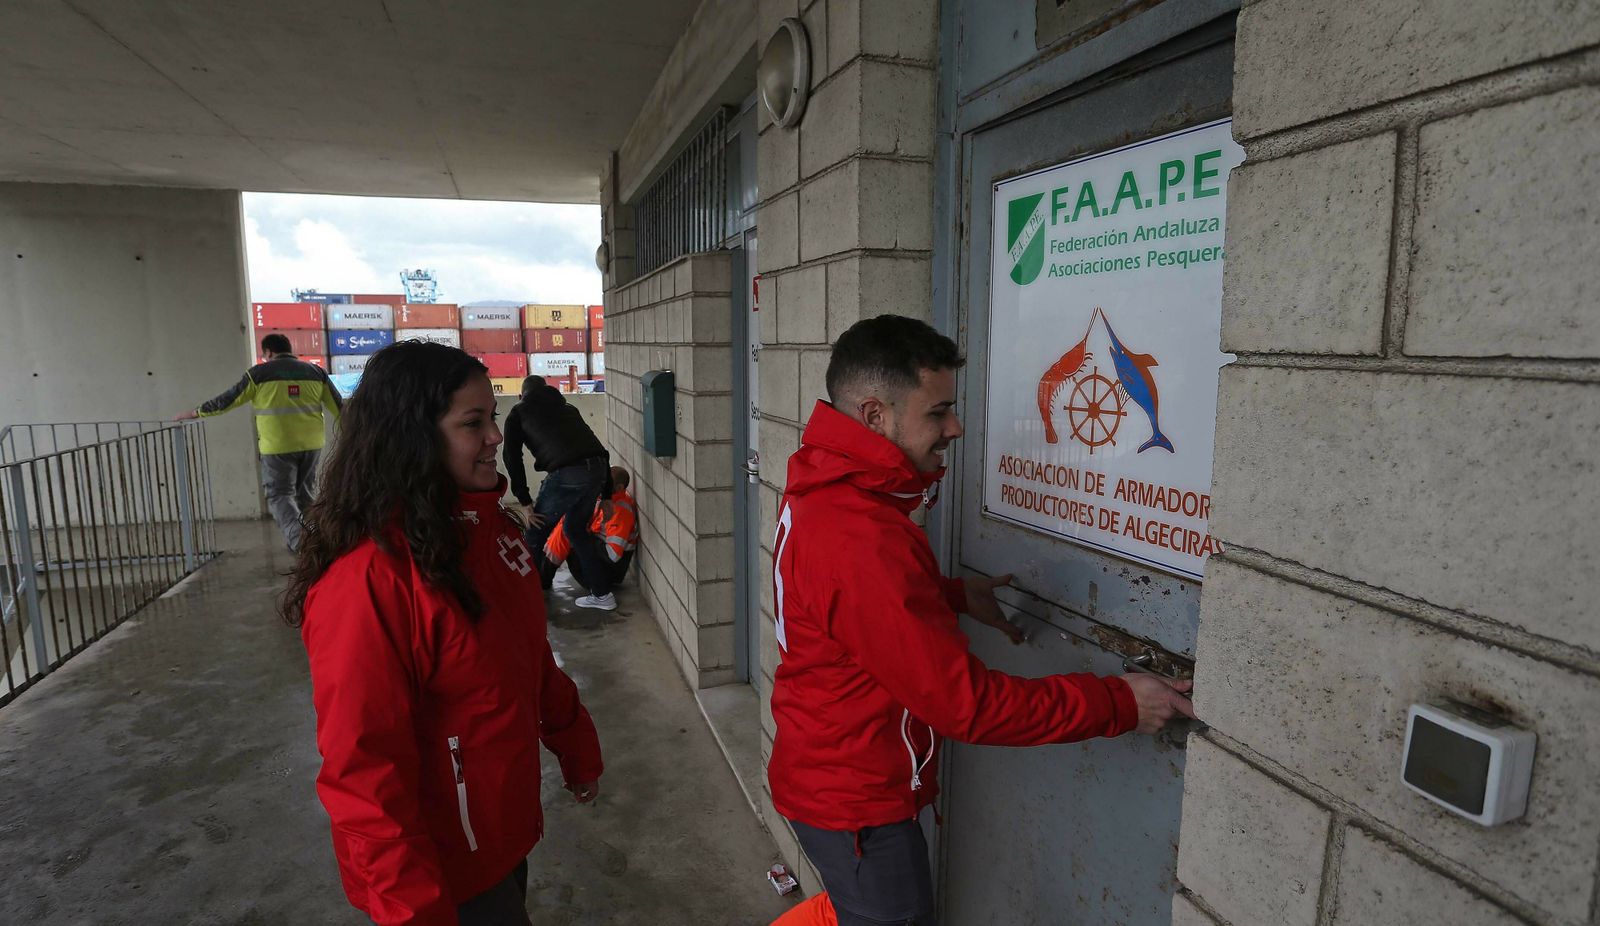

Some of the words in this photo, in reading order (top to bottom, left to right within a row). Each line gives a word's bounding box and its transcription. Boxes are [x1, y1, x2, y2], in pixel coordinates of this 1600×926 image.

[1050, 229, 1128, 255] Federación
[1133, 217, 1220, 243] Andaluza
[1048, 255, 1141, 278] Asociaciones
[998, 454, 1080, 490] ASOCIACION
[1084, 471, 1106, 497] DE
[1001, 483, 1095, 527] PRODUCTORES
[1098, 508, 1121, 534] DE
